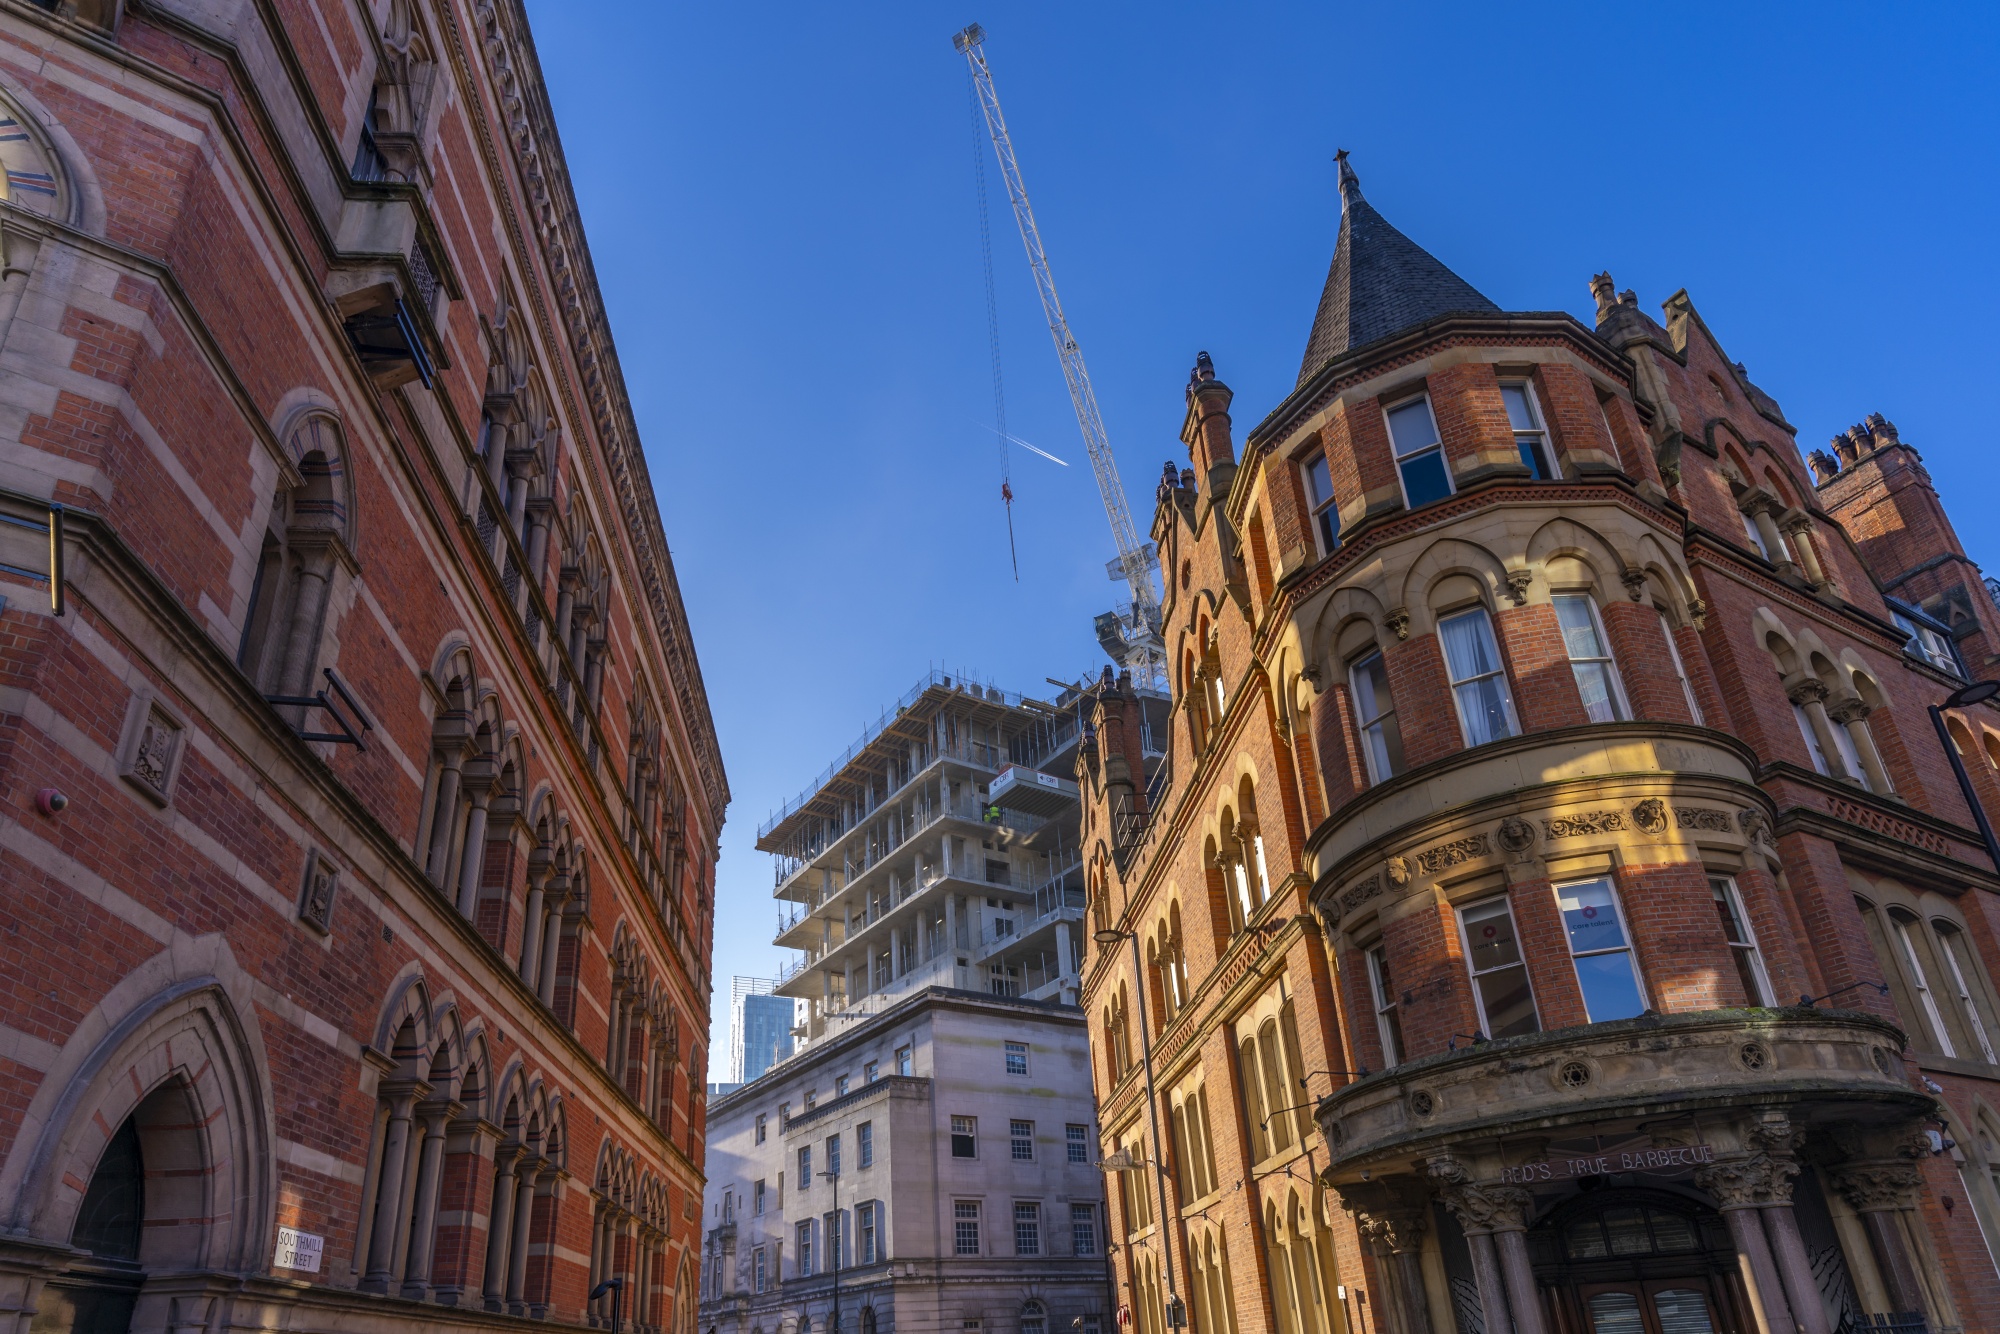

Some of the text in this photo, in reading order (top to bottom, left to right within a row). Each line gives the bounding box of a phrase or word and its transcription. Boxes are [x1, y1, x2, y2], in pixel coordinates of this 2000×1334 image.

[1590, 919, 1614, 928] talent
[1501, 1147, 1714, 1184] RED'S TRUE BARBECUE
[279, 1231, 321, 1252] SOUTHMILL
[283, 1250, 312, 1267] STREET
